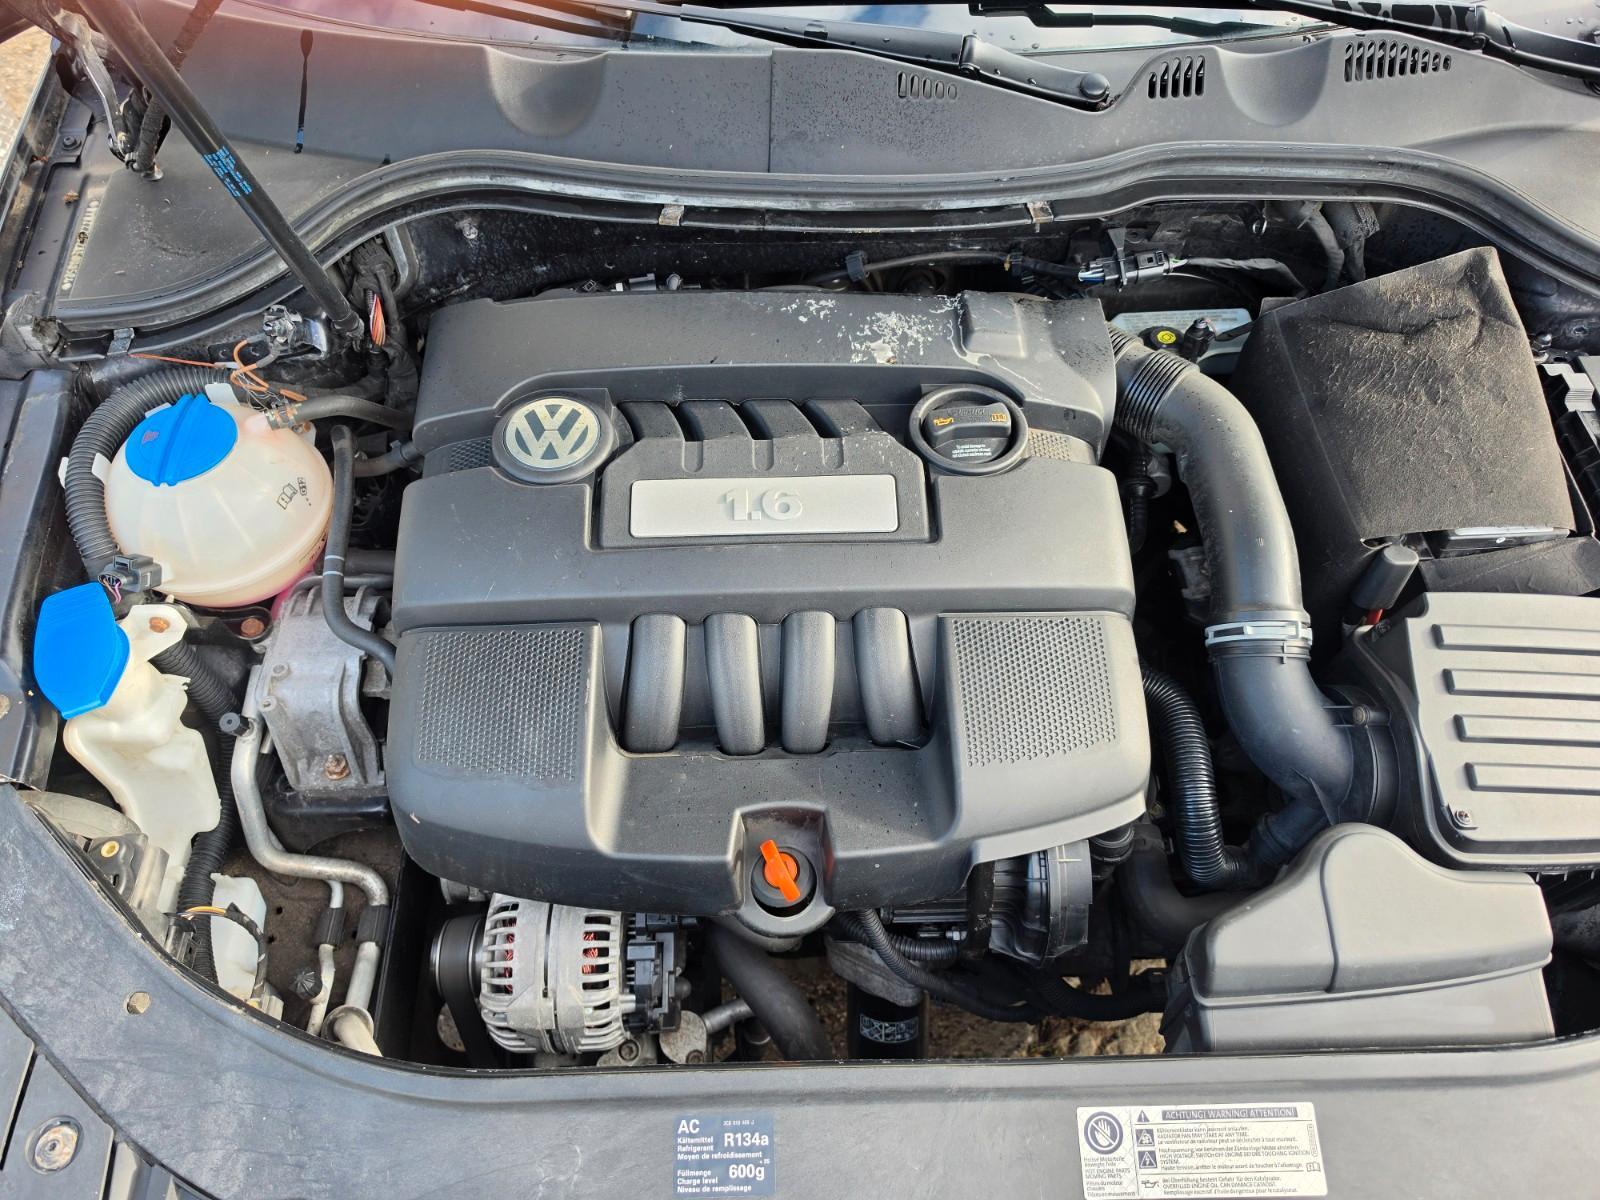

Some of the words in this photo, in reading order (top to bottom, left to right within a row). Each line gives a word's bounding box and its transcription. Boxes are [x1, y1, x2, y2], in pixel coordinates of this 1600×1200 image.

[722, 488, 803, 522] 1.6
[677, 1119, 700, 1134] AC
[724, 1132, 769, 1147] R134a
[677, 1145, 714, 1153] Refrigerant
[677, 1153, 699, 1161] Moyen
[701, 1153, 709, 1161] de
[711, 1151, 762, 1161] refroidissement
[677, 1169, 711, 1177] Füllmenge
[729, 1164, 765, 1181] 600g
[677, 1177, 700, 1185] Charge
[702, 1177, 718, 1185] level
[712, 1185, 752, 1193] remplissage
